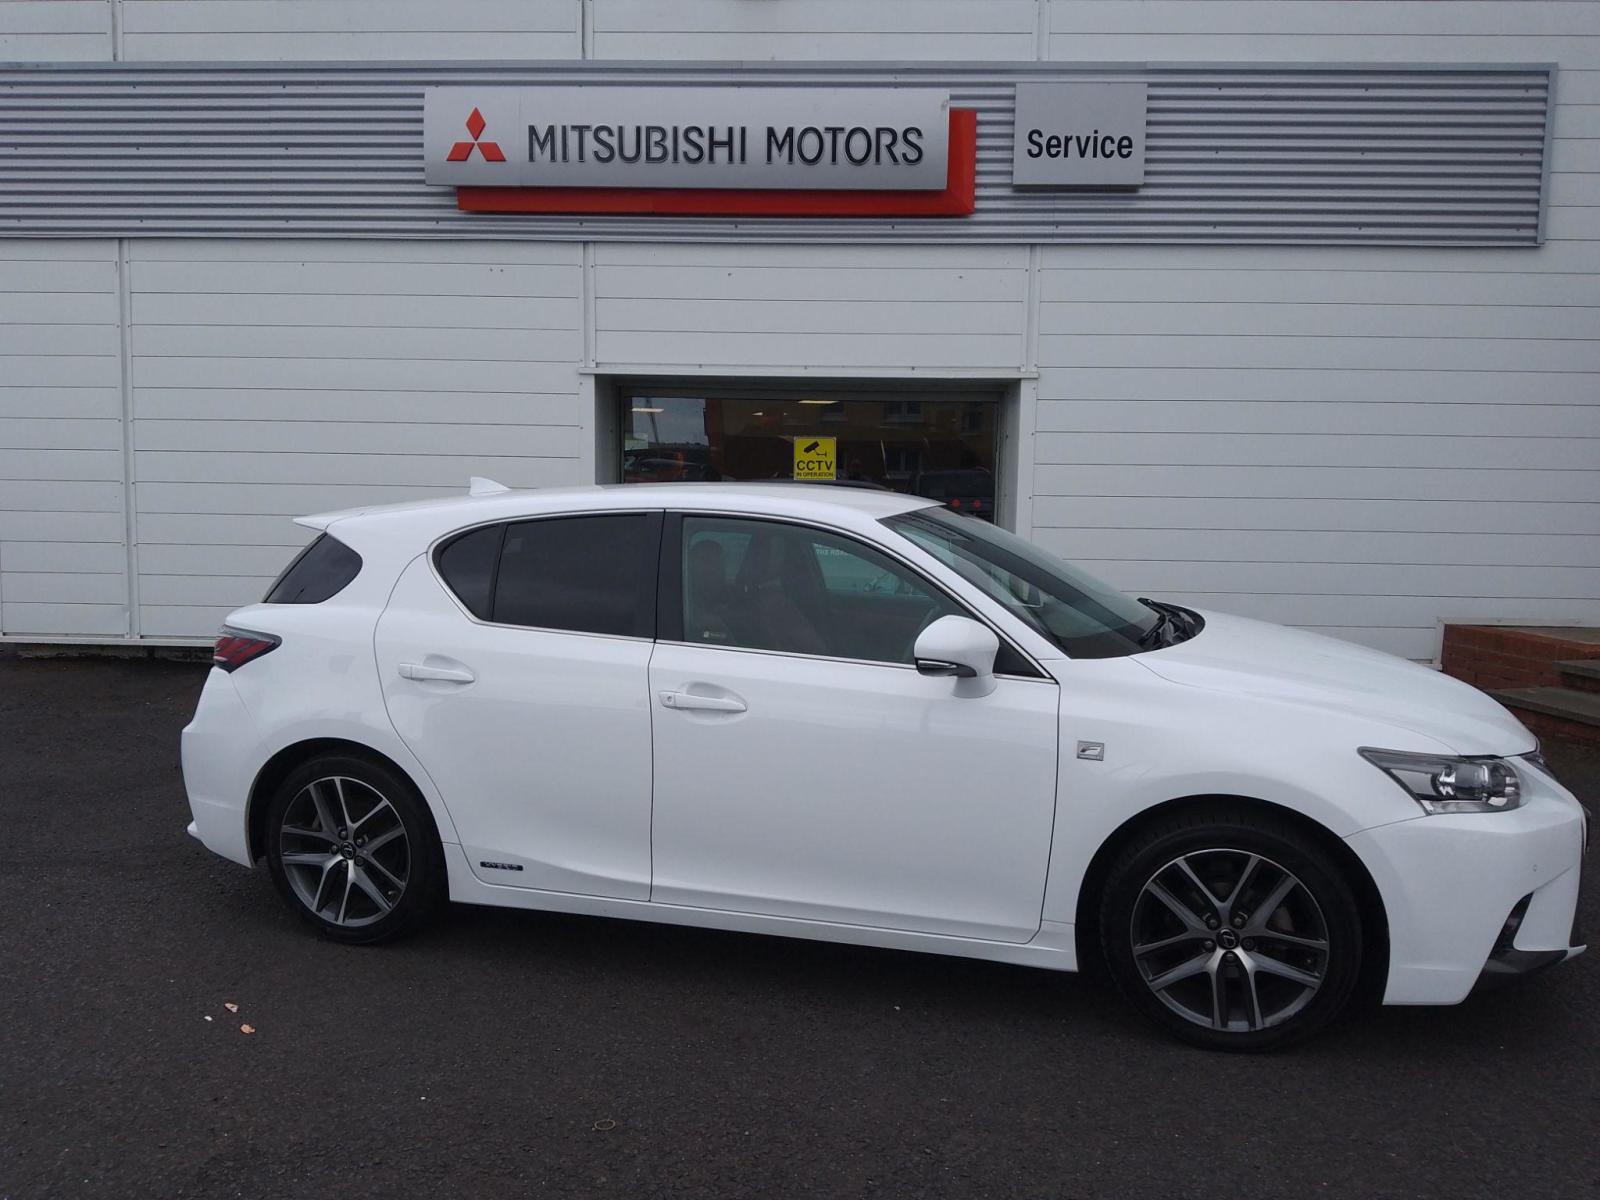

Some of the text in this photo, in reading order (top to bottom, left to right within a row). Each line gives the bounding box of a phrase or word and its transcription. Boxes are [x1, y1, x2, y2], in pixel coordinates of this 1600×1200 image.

[527, 124, 923, 165] MITSUBISHI MOTORS
[1028, 129, 1133, 159] Service
[796, 460, 833, 471] CCTV
